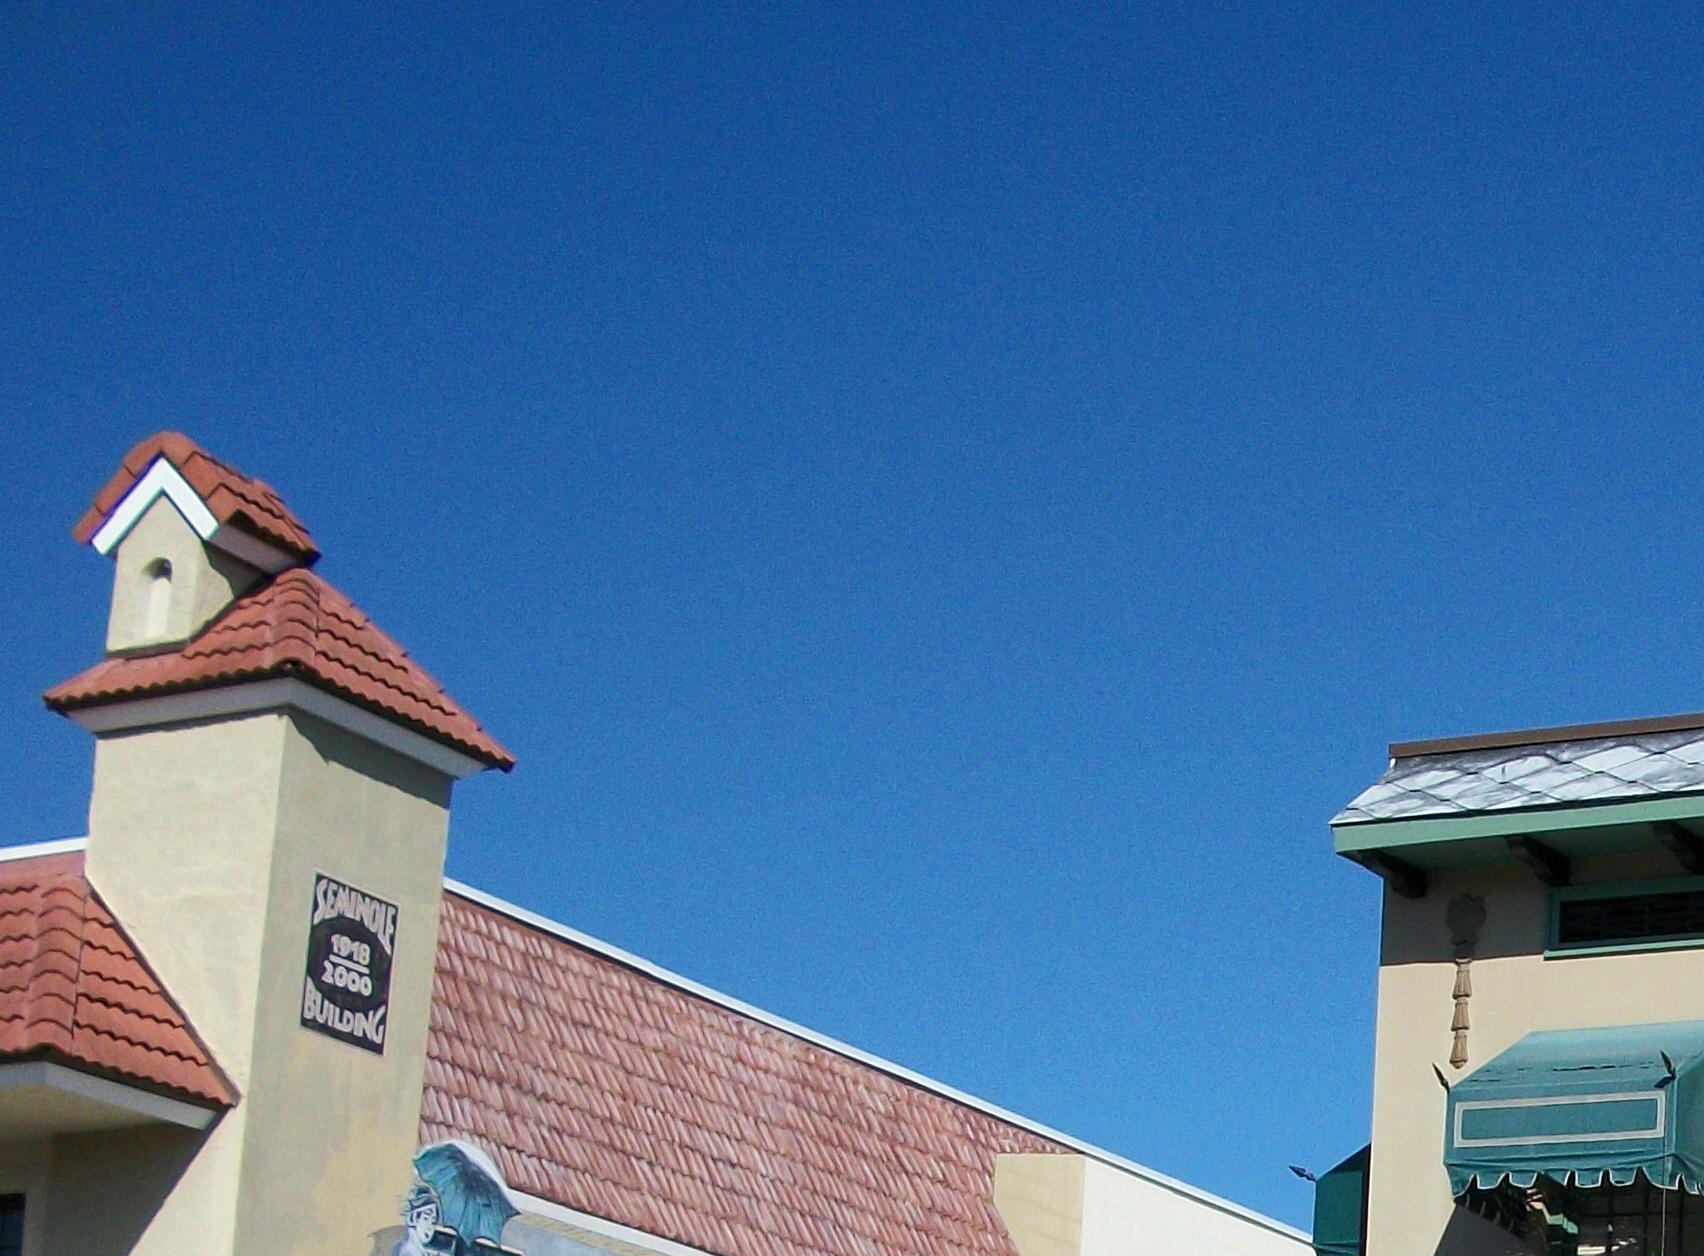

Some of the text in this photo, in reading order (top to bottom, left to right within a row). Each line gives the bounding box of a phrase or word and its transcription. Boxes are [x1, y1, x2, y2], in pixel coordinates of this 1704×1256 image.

[314, 878, 396, 955] SEMINOLE
[304, 976, 386, 1044] BUILDING
[321, 960, 372, 996] 2000
